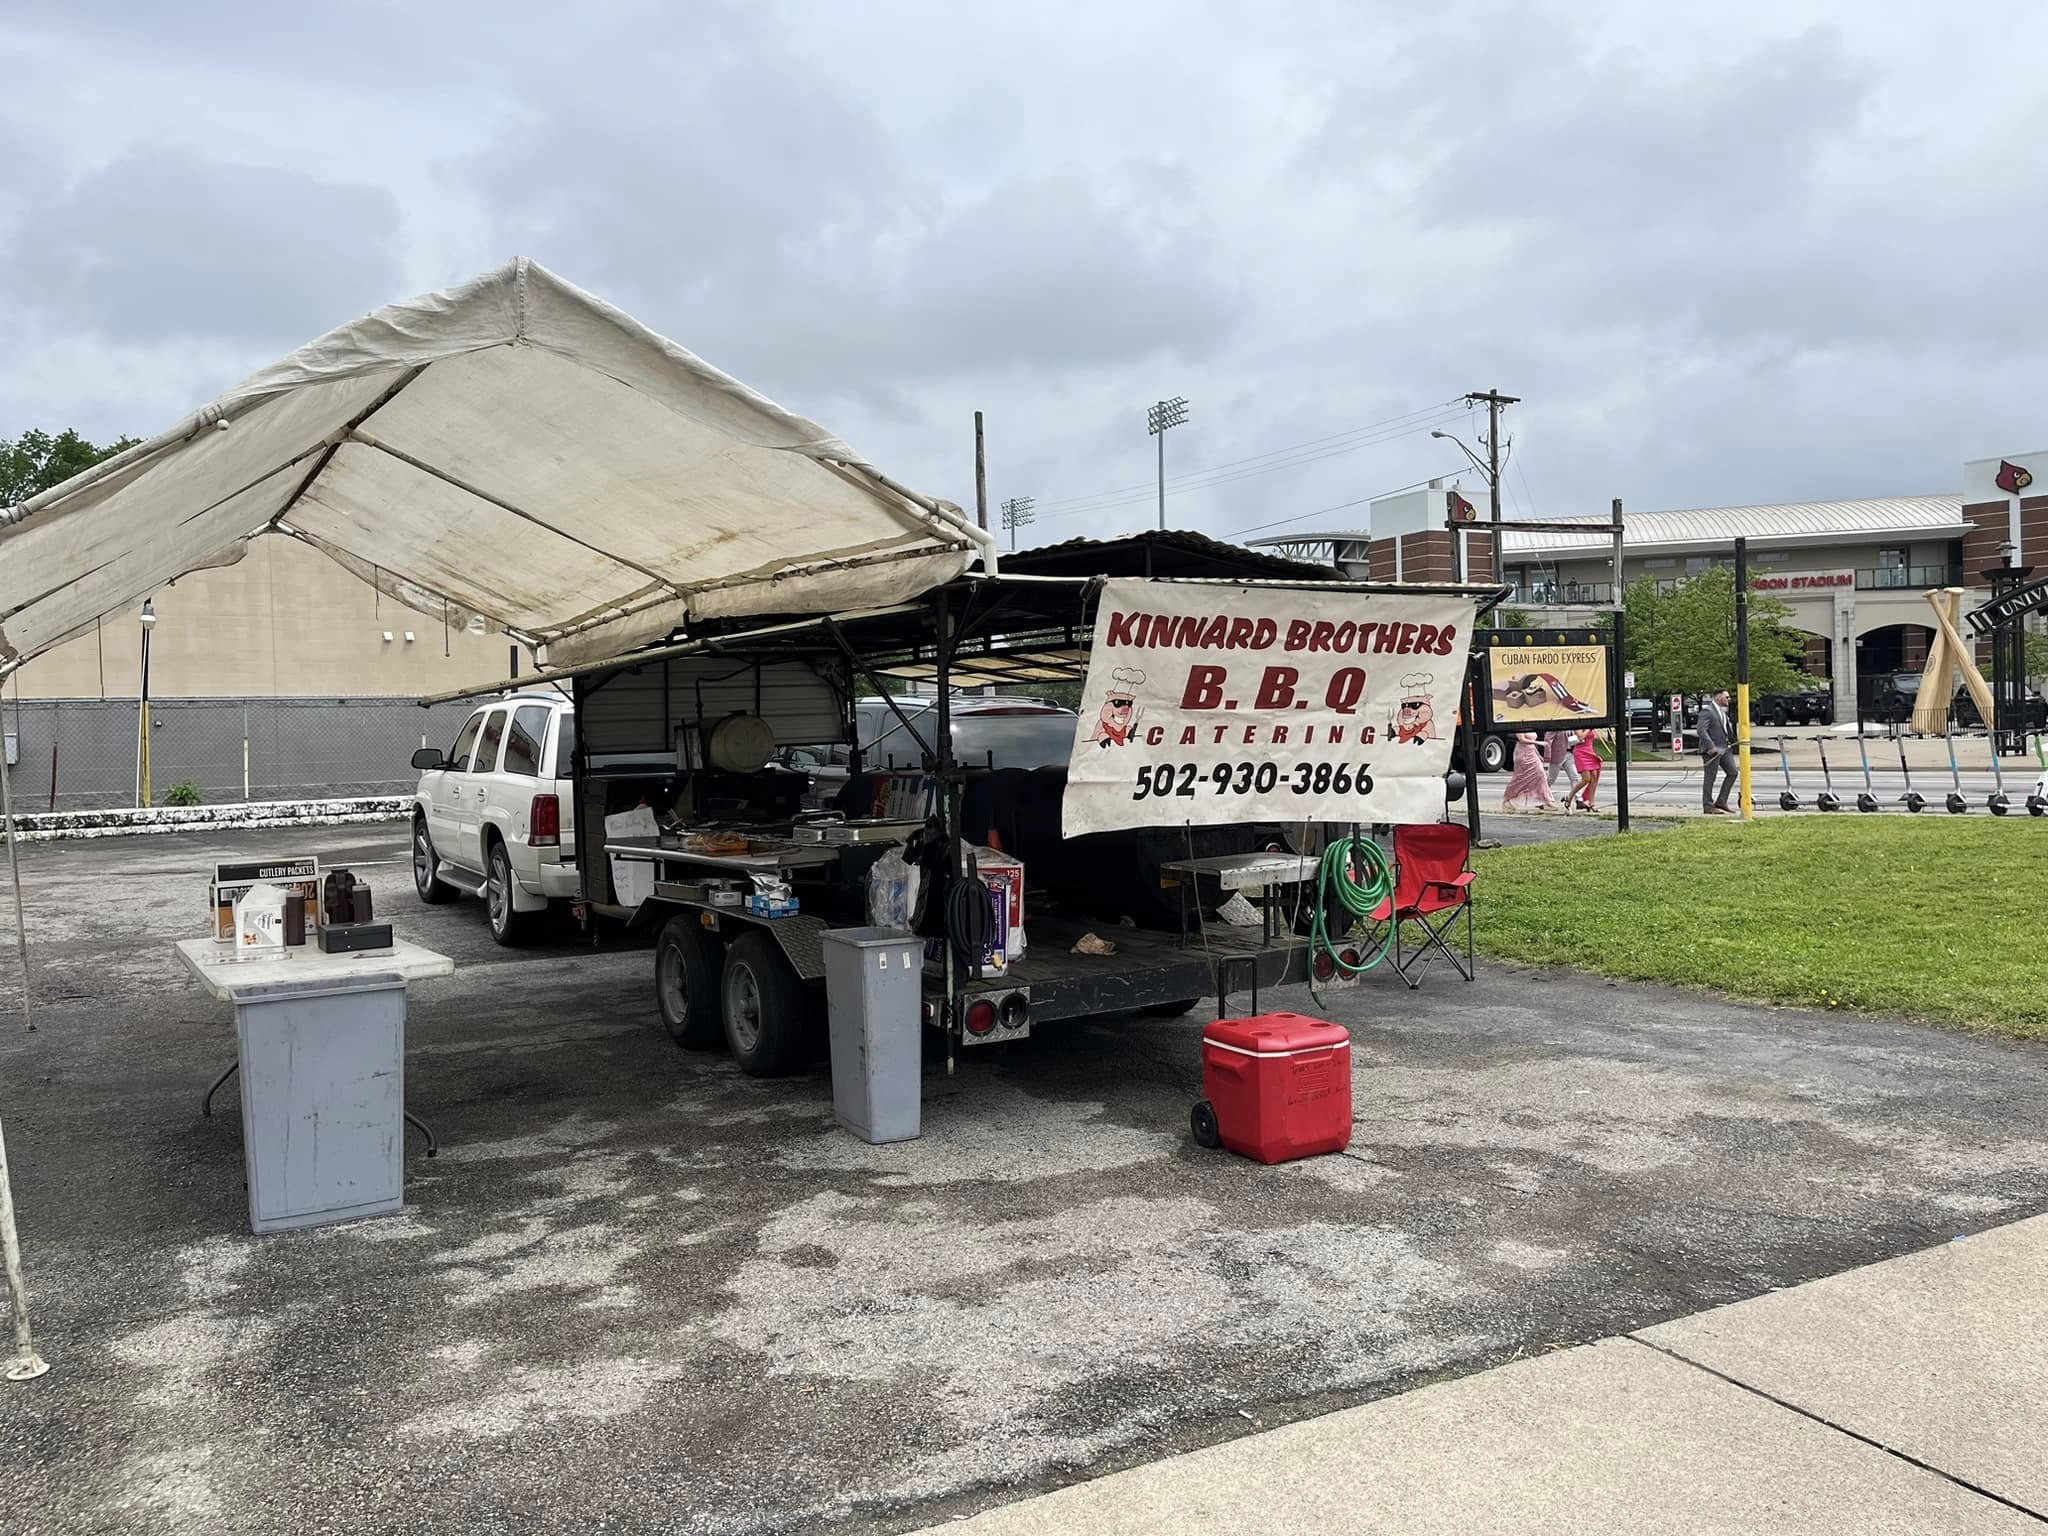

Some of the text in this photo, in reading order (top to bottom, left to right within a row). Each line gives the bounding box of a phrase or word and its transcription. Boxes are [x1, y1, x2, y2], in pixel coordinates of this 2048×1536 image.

[1791, 575, 1853, 589] STADIUM
[1106, 612, 1456, 656] KINNARD BROTHERS
[1501, 652, 1596, 665] CUBAN FARDO EXPRESS
[1146, 725, 1376, 745] CATERING
[1132, 761, 1374, 801] 502-930-3866
[259, 865, 314, 878] CUTLERY PACKETS
